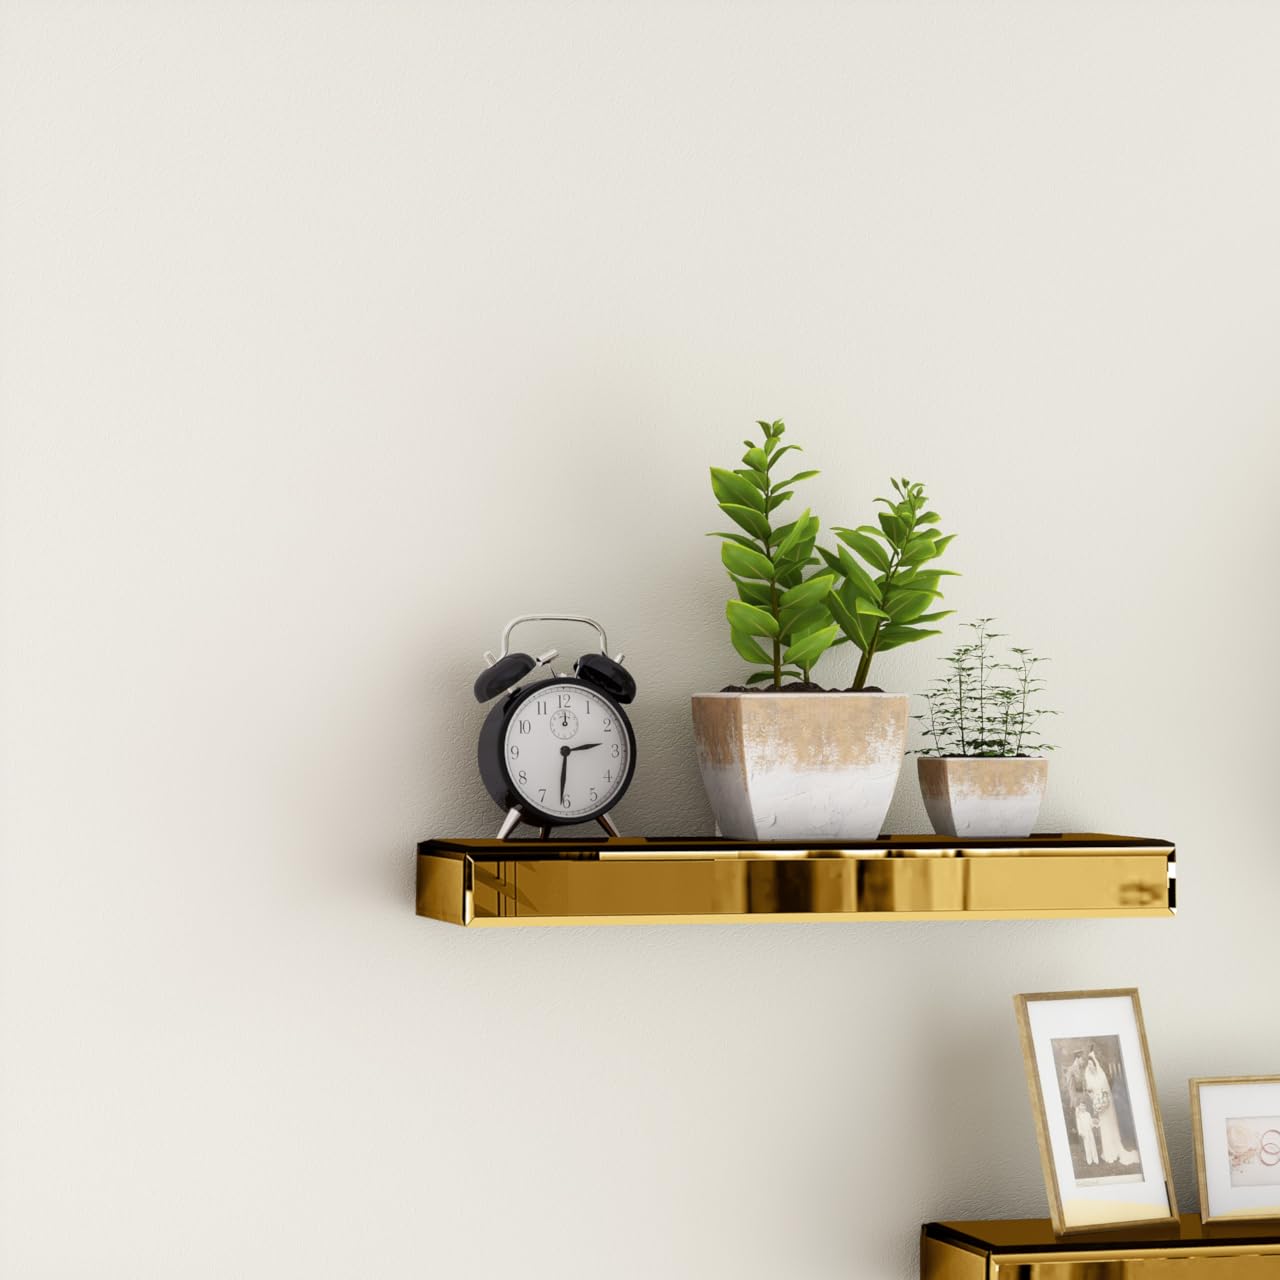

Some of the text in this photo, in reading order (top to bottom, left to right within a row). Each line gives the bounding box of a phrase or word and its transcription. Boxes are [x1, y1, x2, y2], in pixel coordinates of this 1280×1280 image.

[537, 701, 547, 715] 11
[557, 694, 571, 709] 12
[519, 719, 531, 734] 10
[603, 718, 612, 733] 2
[510, 745, 520, 760] 9
[611, 743, 620, 758] 3
[518, 770, 528, 785] 8
[602, 769, 613, 783] 4
[538, 788, 547, 803] 7
[562, 794, 571, 809] 6
[589, 787, 598, 801] 5
